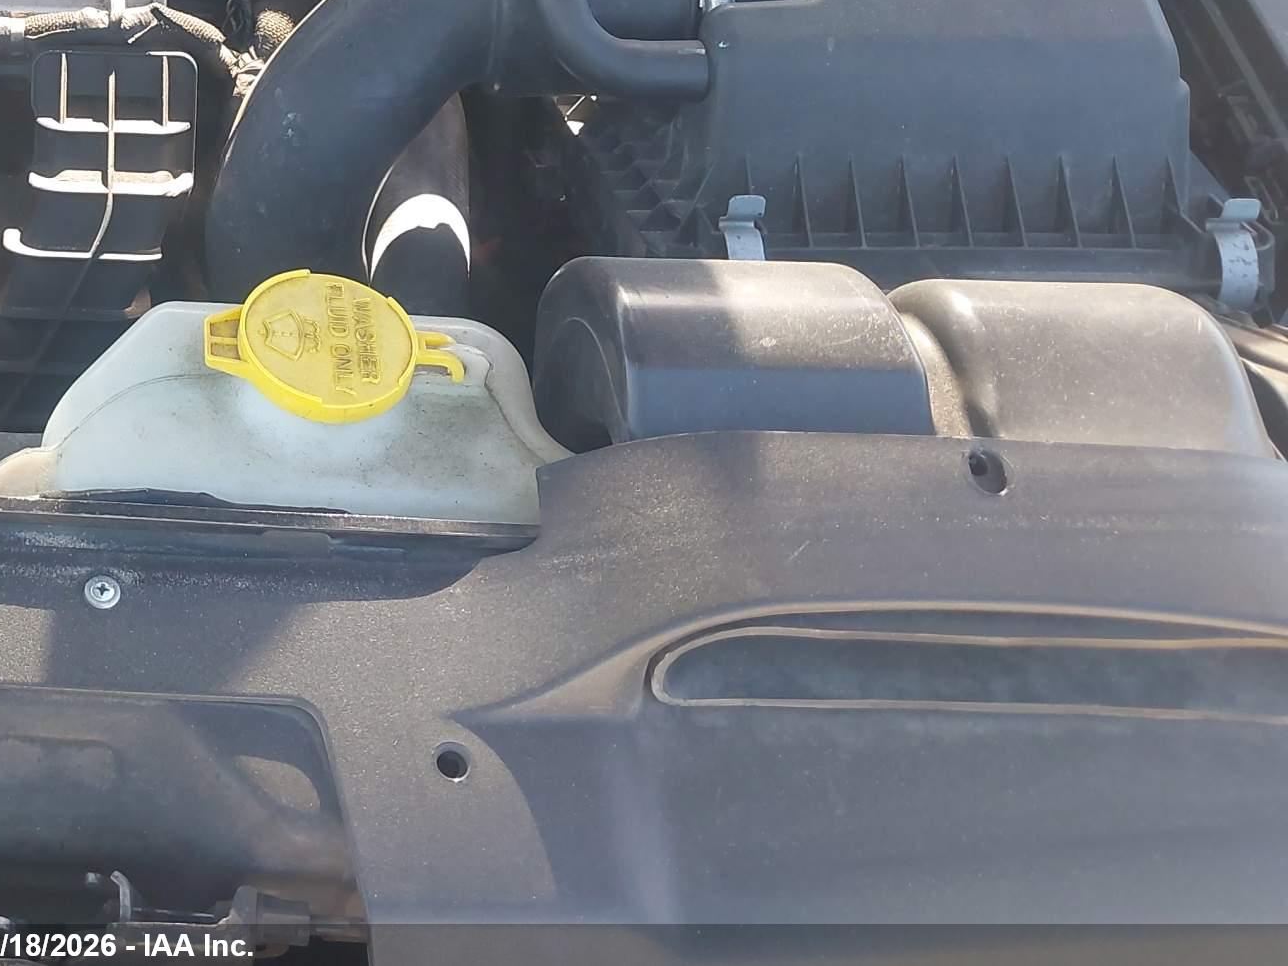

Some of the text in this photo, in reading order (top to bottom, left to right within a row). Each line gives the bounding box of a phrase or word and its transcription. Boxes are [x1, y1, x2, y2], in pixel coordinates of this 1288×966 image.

[326, 282, 357, 395] FLUID ONLY
[352, 297, 381, 384] WASHER
